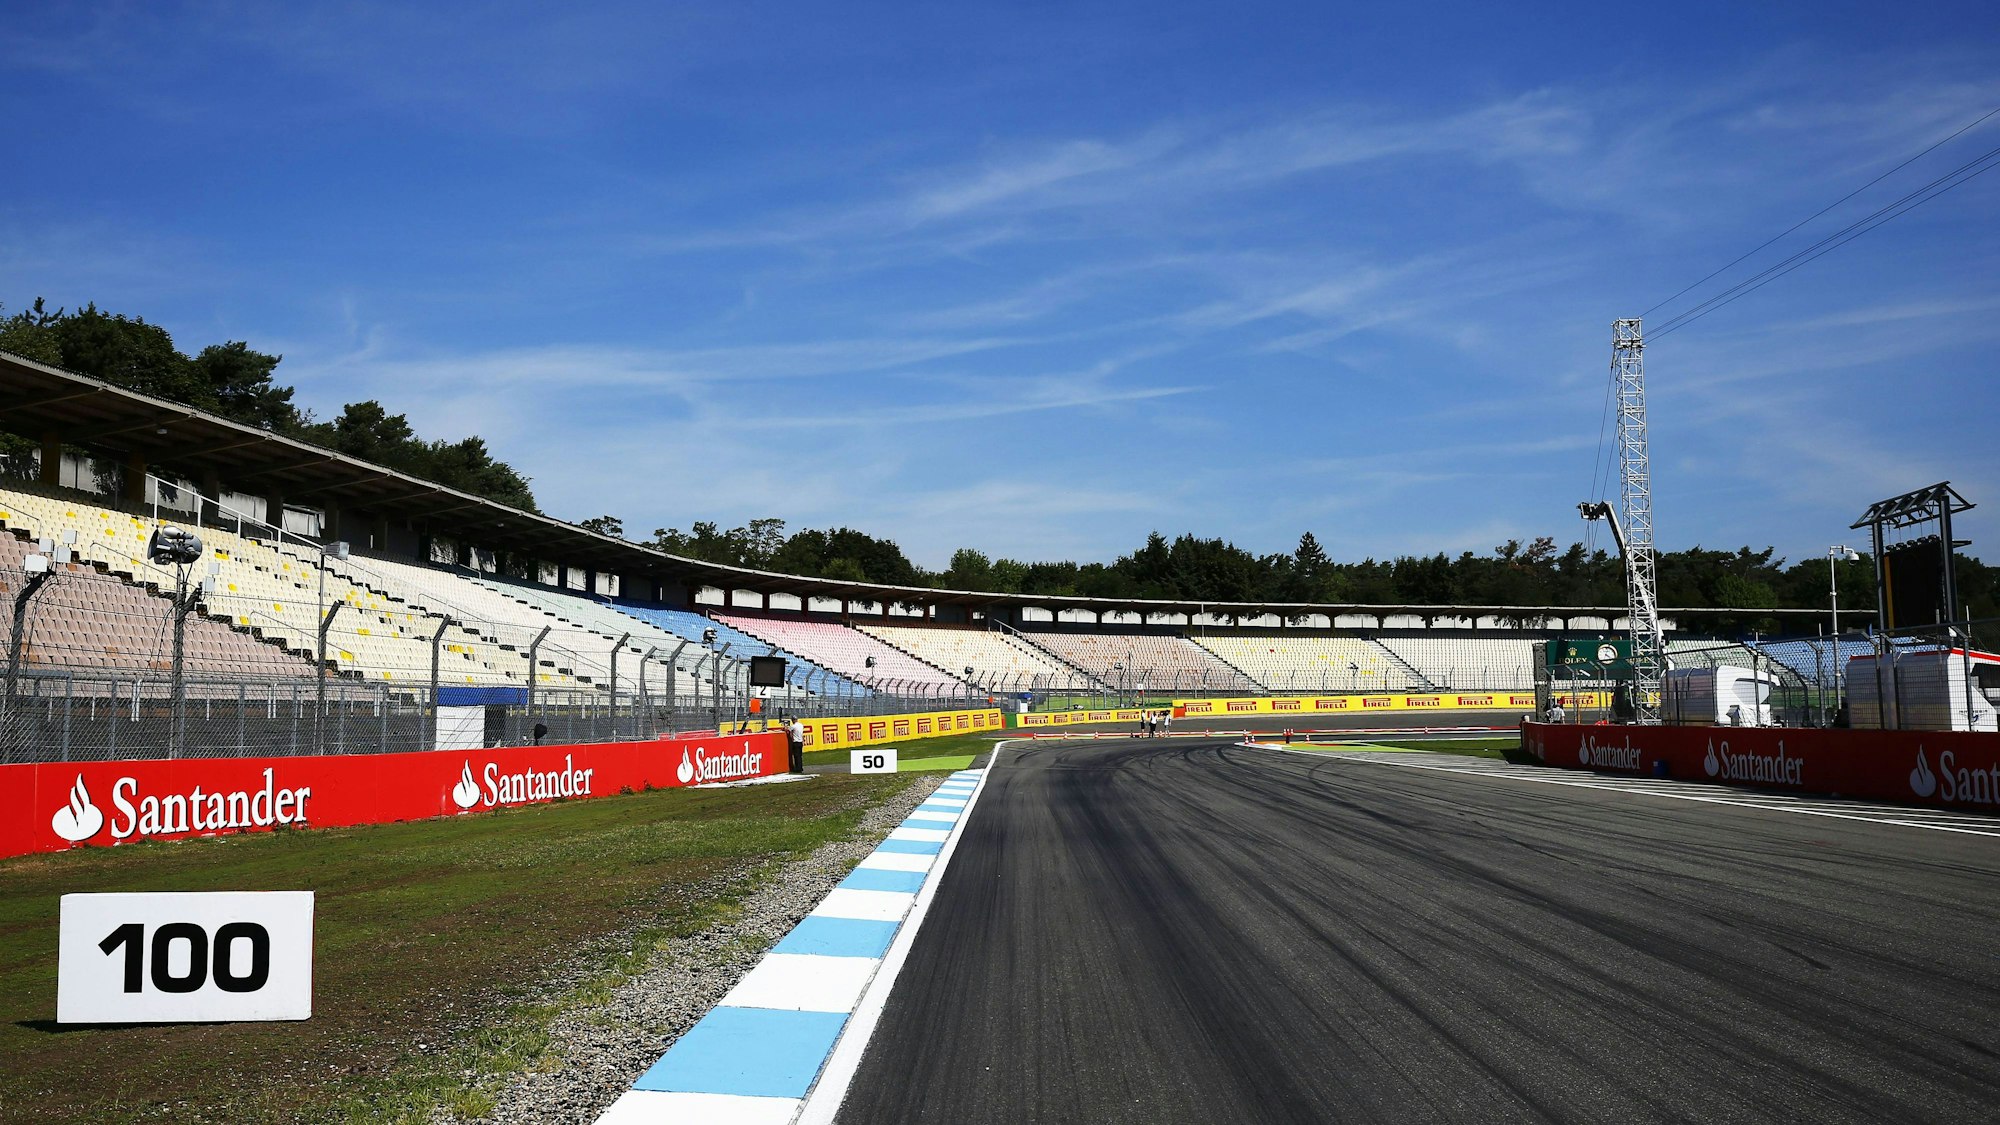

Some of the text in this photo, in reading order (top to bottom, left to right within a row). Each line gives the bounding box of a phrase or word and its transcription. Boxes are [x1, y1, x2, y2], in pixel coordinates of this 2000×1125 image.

[760, 685, 767, 696] 2
[1227, 701, 1257, 712] PIRELLI
[1272, 701, 1301, 710] PIRELLI
[1315, 700, 1347, 709] PIRELLI
[1363, 698, 1391, 708] PIRELLI
[1407, 697, 1440, 707] PIRELLI
[1458, 696, 1493, 706] PIRELLI
[1184, 702, 1213, 712] PIRELLI
[1024, 715, 1049, 725] PIRELLI
[1088, 712, 1111, 721] PIRELLI
[1589, 735, 1641, 770] Santander
[695, 741, 763, 783] Santander
[863, 755, 886, 769] 50
[1720, 740, 1804, 785] Santander
[484, 754, 594, 807] Santander
[111, 768, 311, 838] Santander
[98, 922, 270, 993] 100
